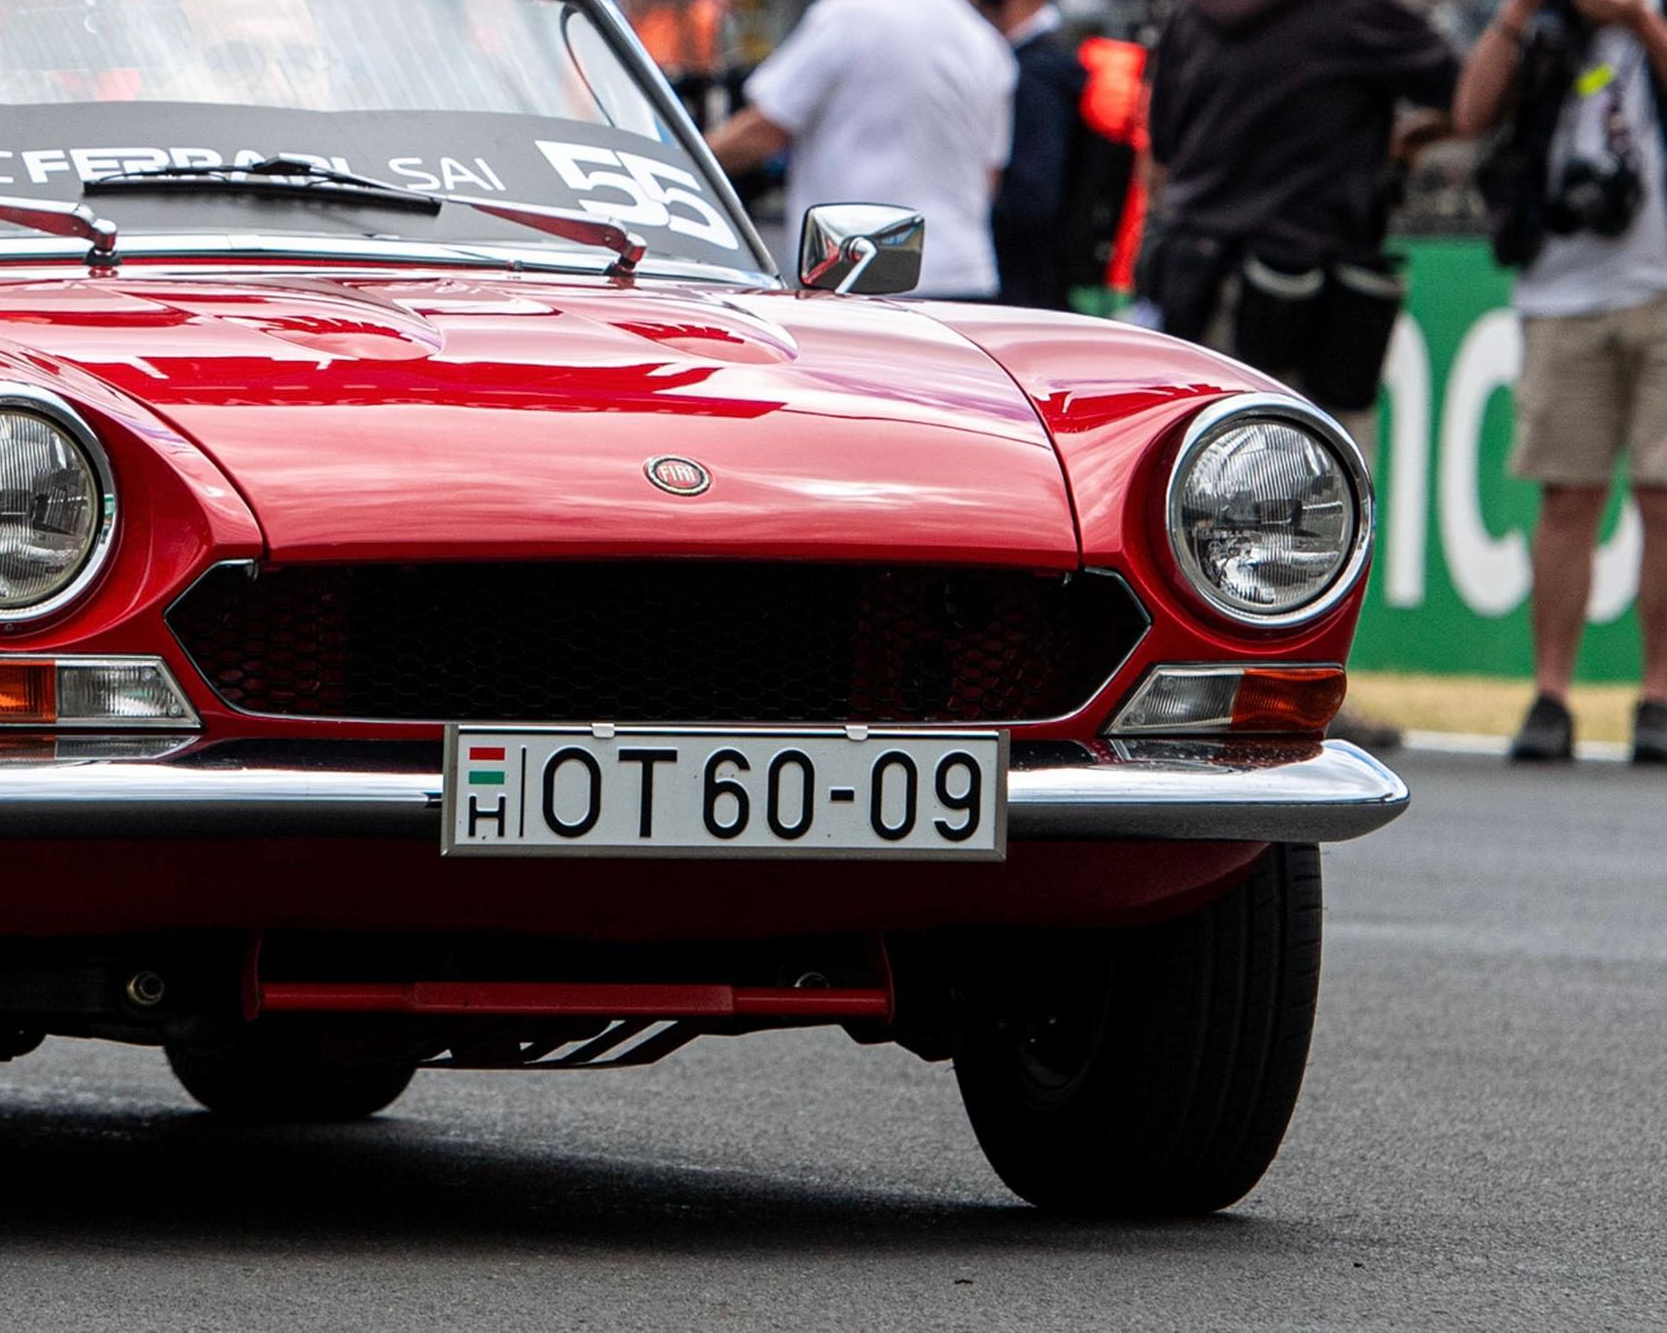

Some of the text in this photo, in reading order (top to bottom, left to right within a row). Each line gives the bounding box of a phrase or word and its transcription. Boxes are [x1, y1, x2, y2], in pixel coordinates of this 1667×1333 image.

[388, 157, 507, 191] SAI
[534, 140, 739, 251] 55
[659, 464, 696, 483] FIAT
[468, 795, 505, 837] H
